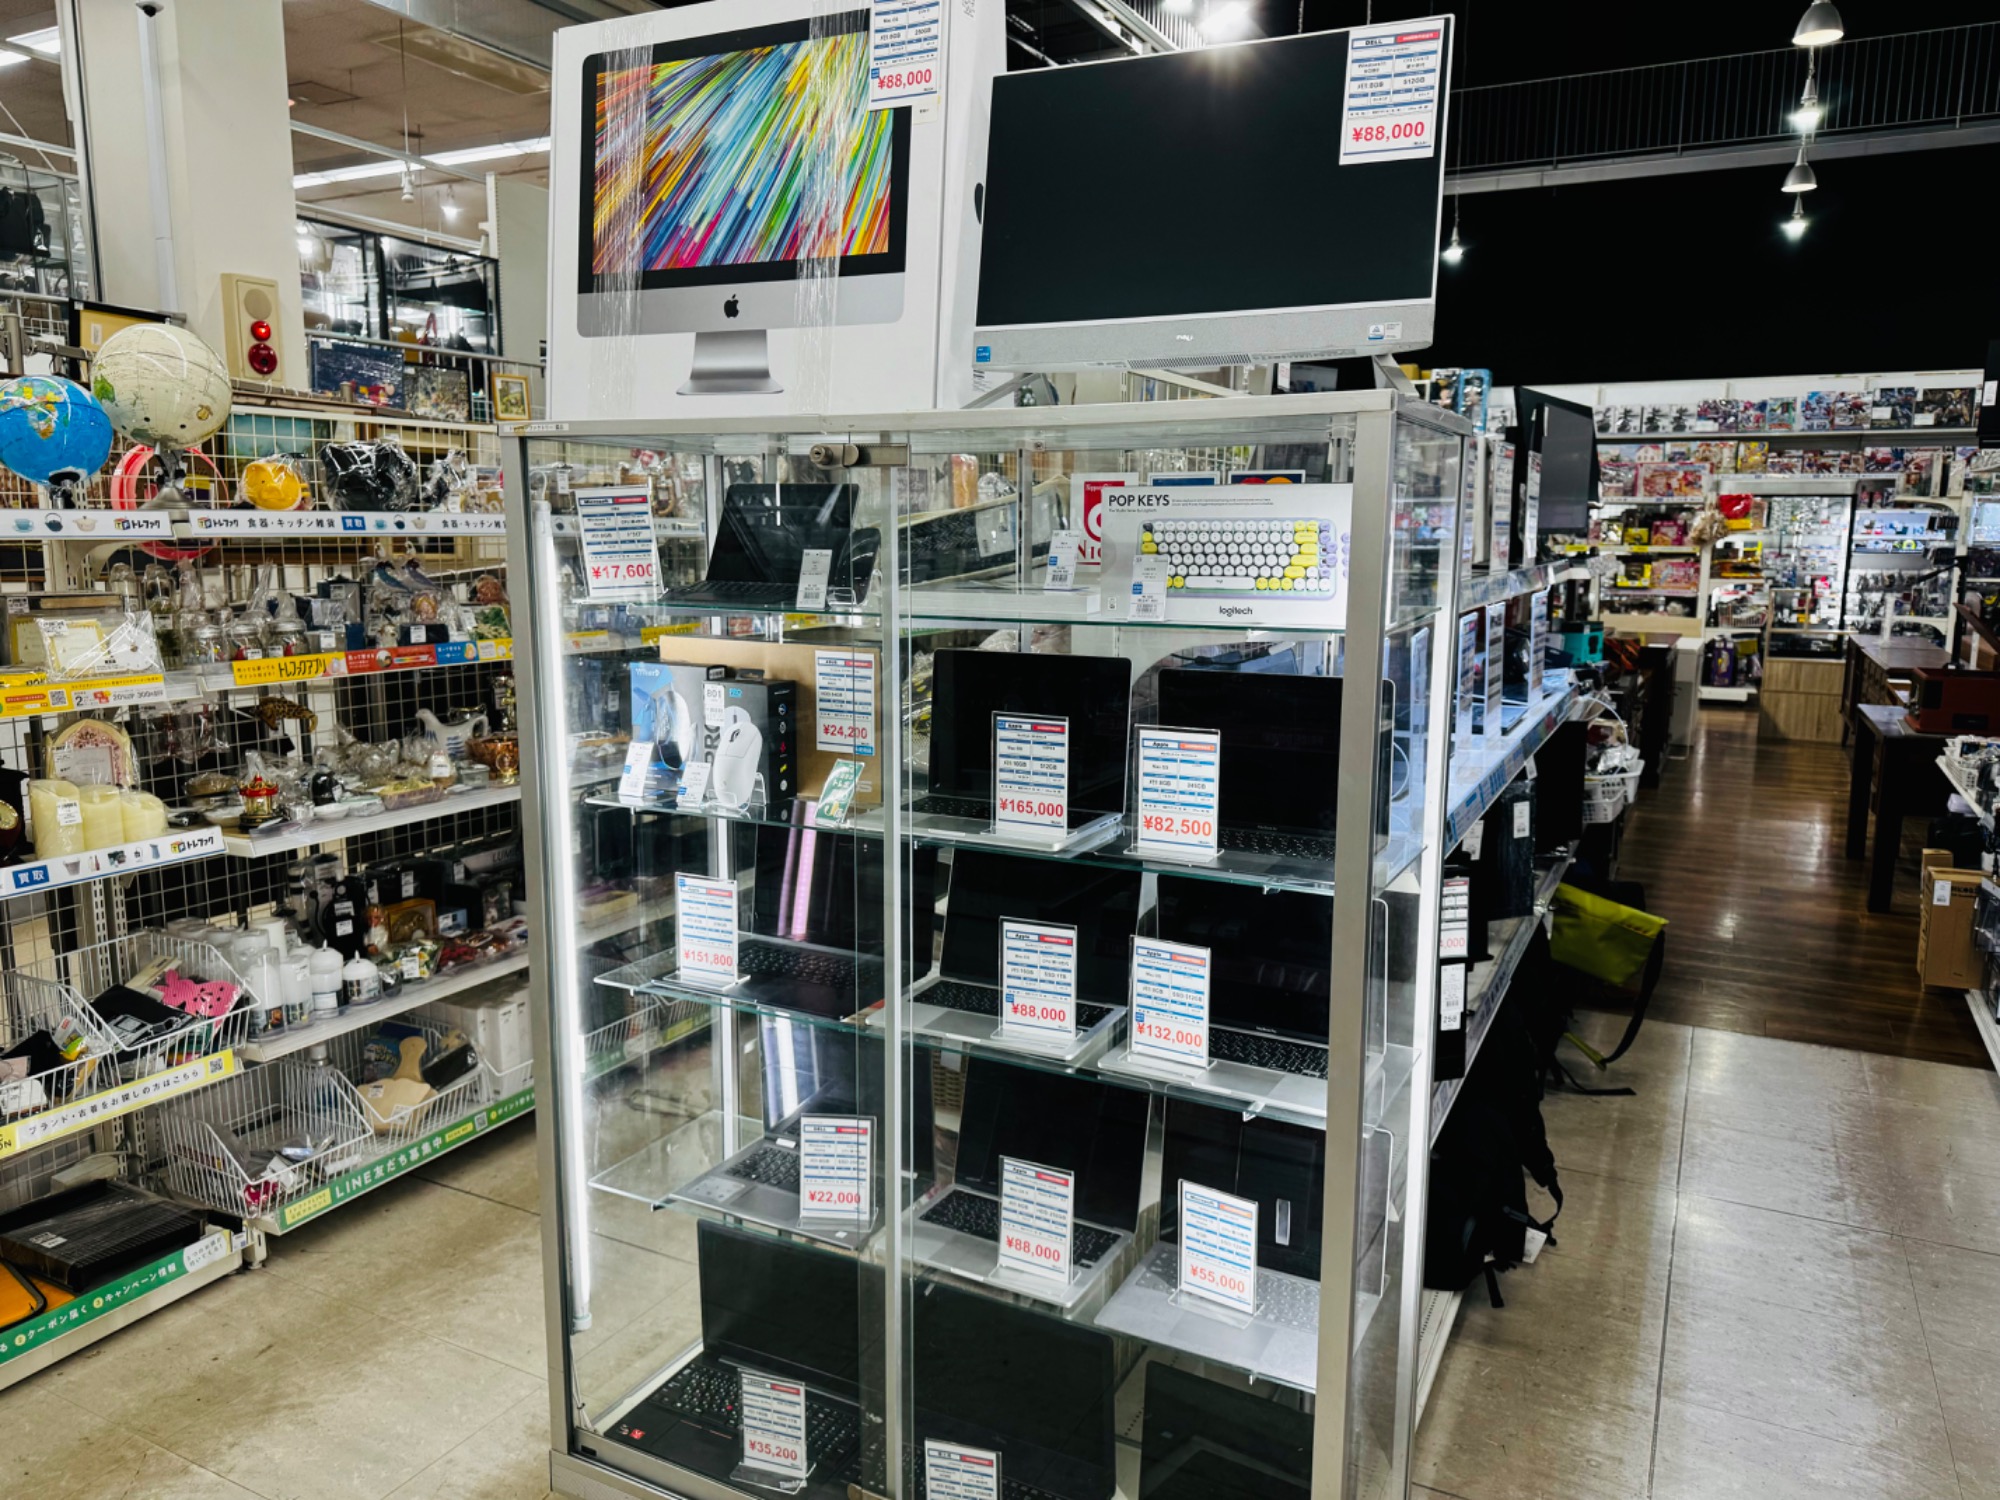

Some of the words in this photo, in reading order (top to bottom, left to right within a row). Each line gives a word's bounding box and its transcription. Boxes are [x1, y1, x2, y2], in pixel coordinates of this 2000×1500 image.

[878, 68, 932, 89] ¥88,000
[1352, 121, 1425, 142] ¥88,000
[1108, 494, 1135, 507] POP
[1137, 494, 1170, 507] KEYS
[1219, 606, 1253, 617] logitech
[823, 723, 867, 739] ¥24,200
[999, 797, 1063, 817] ¥165,000
[1143, 814, 1212, 837] ¥82,500
[18, 869, 44, 884] 買取
[683, 949, 733, 967] ¥151,800
[1011, 1003, 1066, 1022] ¥88,000
[1137, 1022, 1202, 1047] ¥132,000
[29, 1069, 199, 1135] ブランド・古着をお探しの方はこちら
[335, 1136, 442, 1199] LINE友だち募集中
[809, 1190, 861, 1205] ¥22,000
[1006, 1235, 1060, 1262] ¥88,000
[1190, 1264, 1245, 1293] ¥55,000
[749, 1439, 798, 1461] ¥35,200
